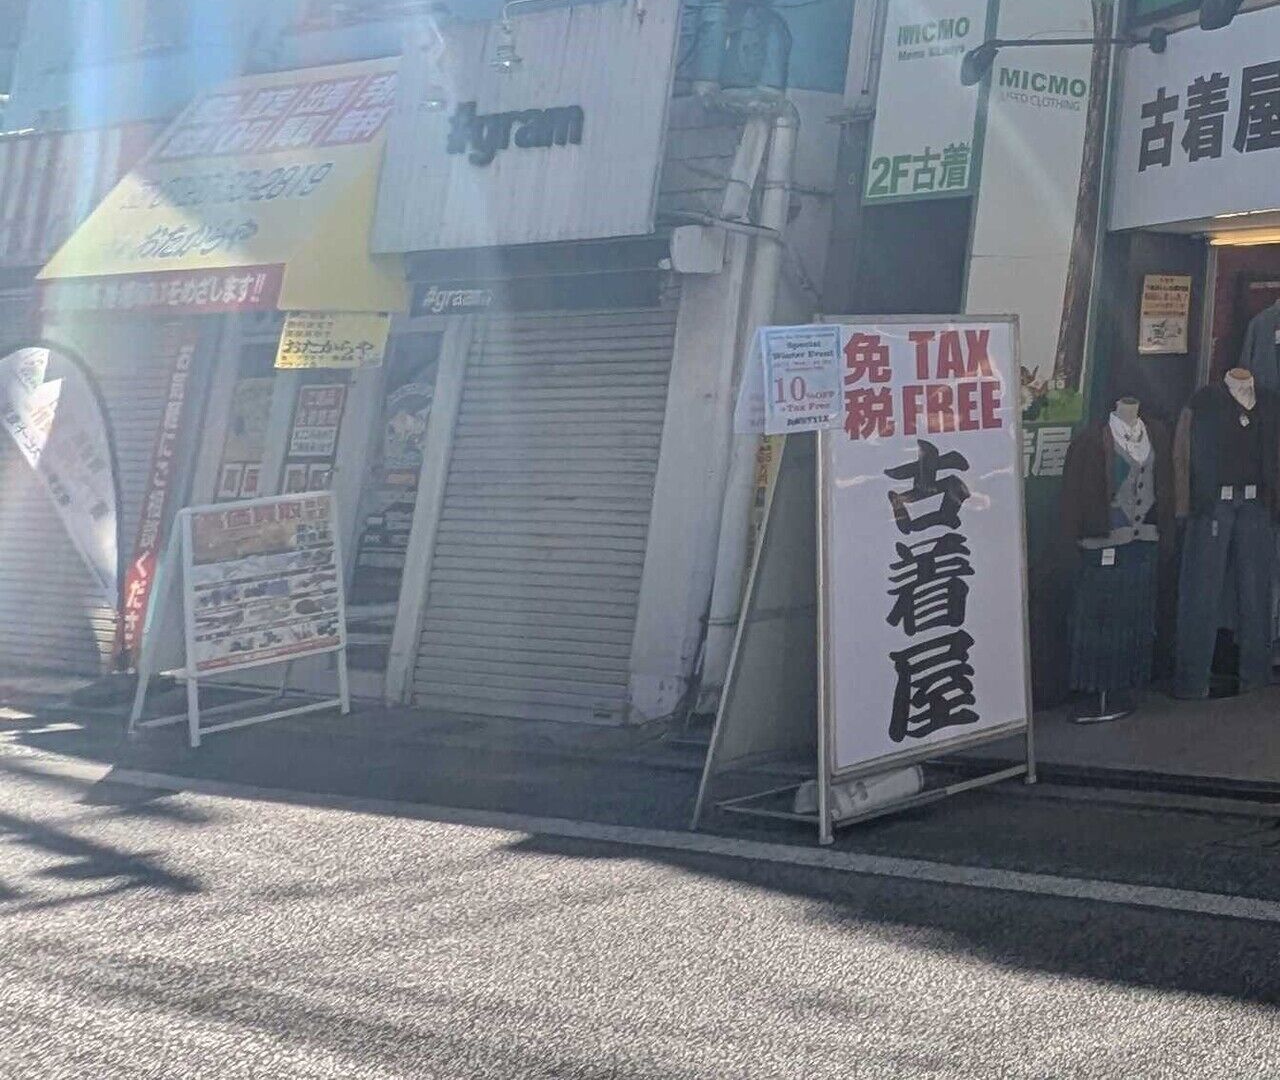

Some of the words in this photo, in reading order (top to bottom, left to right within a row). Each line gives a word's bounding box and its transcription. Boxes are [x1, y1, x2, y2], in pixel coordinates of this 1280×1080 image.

[898, 16, 971, 47] MICMO
[1000, 67, 1087, 99] MICMO
[908, 329, 990, 380] TAX
[774, 376, 806, 404] 10
[902, 380, 1004, 434] FREE
[884, 438, 981, 743] 古着屋
